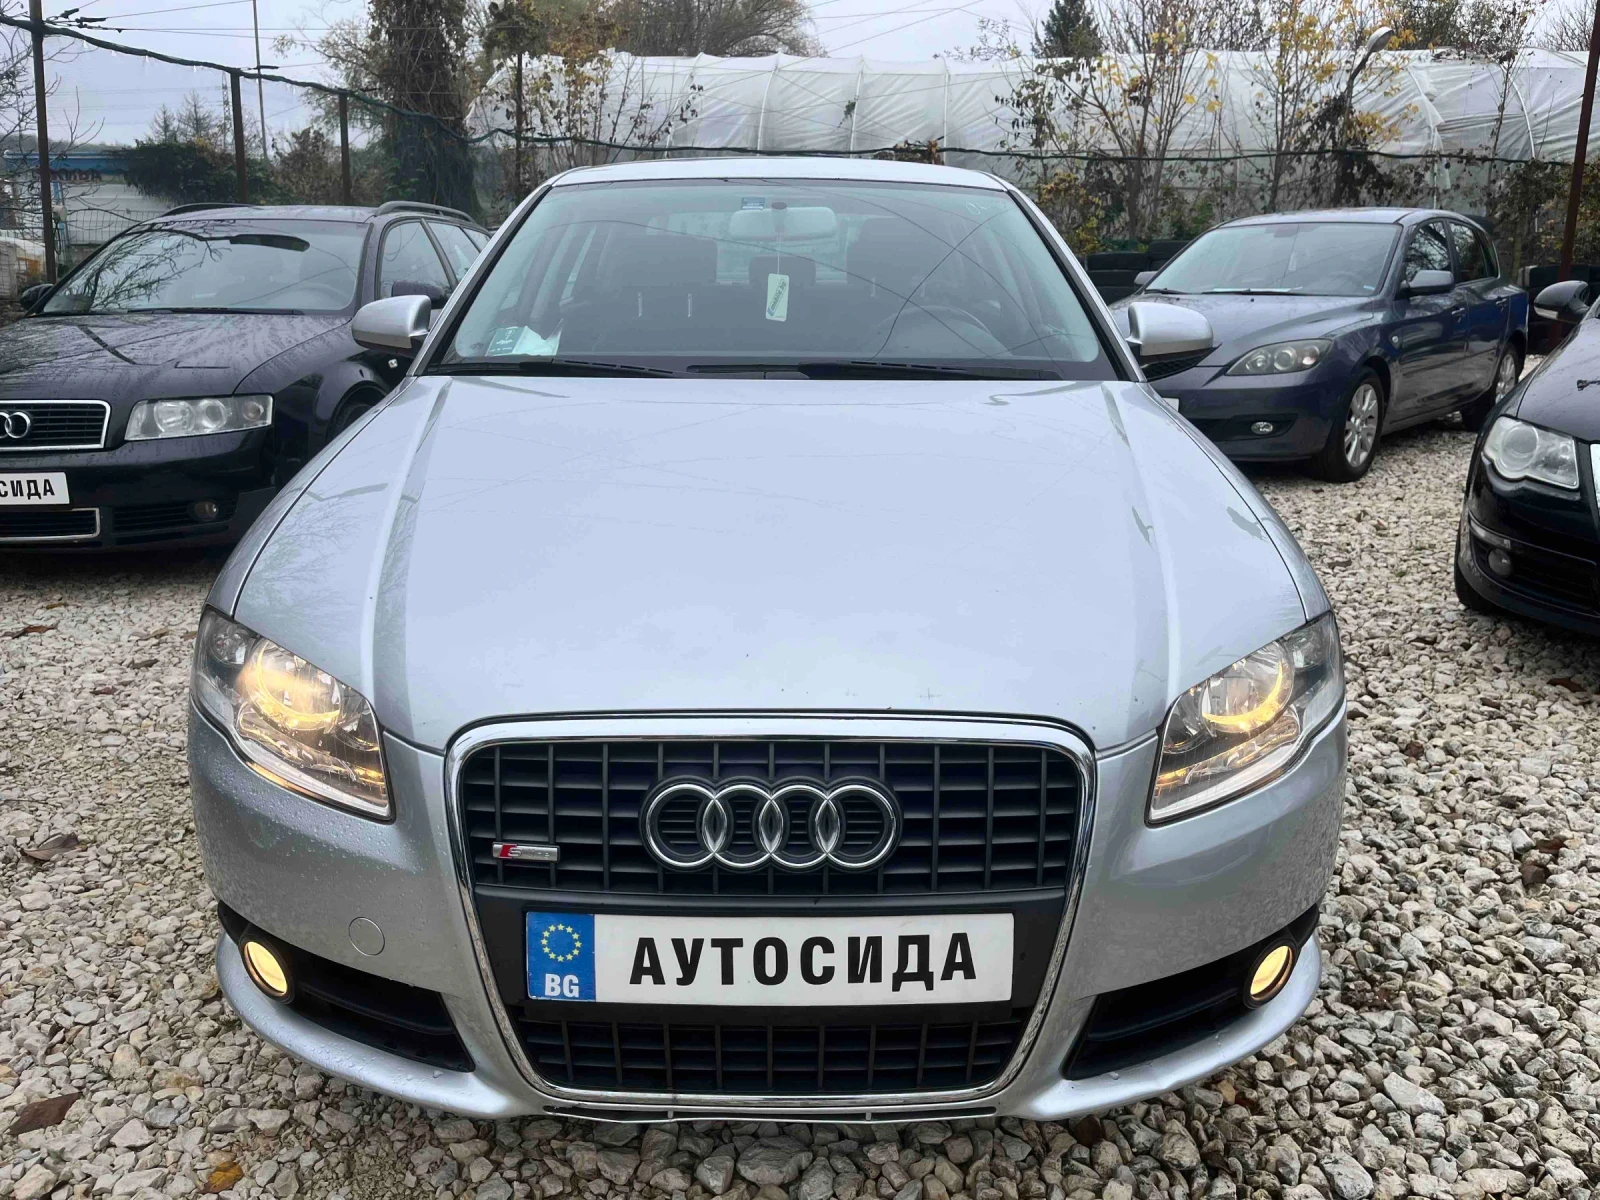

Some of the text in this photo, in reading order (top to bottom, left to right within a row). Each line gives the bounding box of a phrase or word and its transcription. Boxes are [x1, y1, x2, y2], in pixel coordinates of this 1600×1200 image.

[0, 479, 55, 500] СИДА
[629, 932, 977, 992] АУТОСИДА
[545, 973, 580, 998] BG
